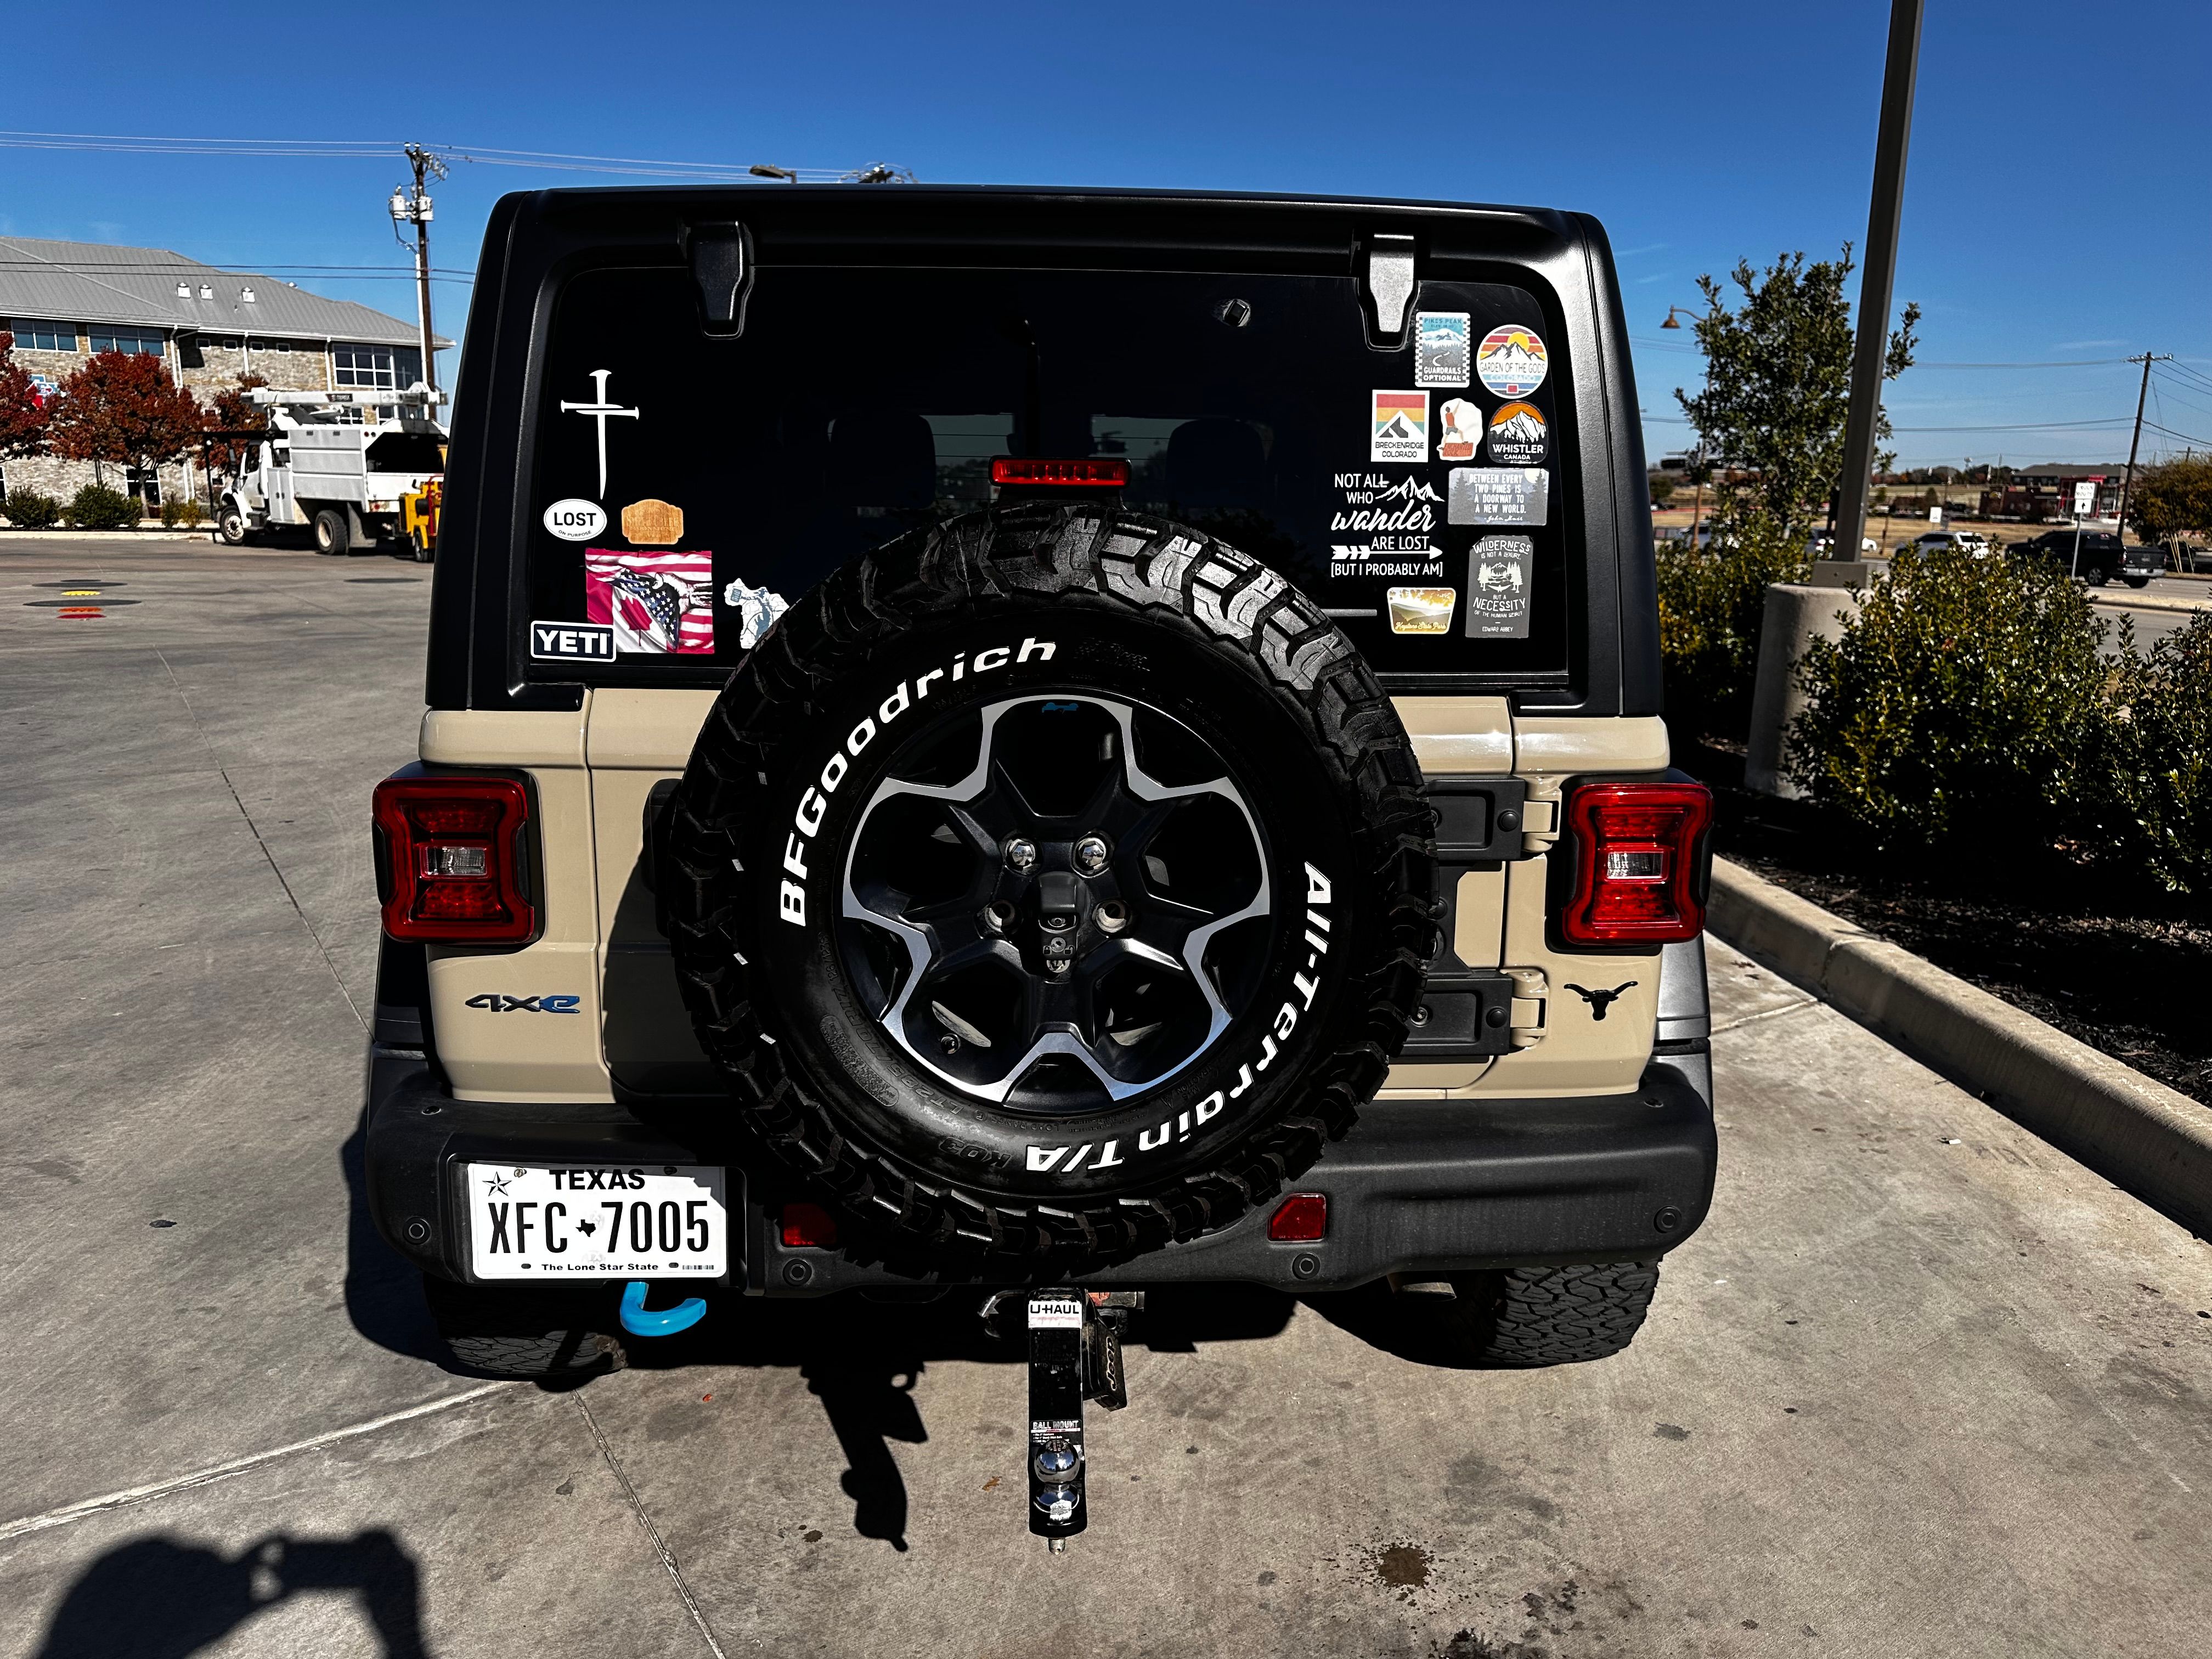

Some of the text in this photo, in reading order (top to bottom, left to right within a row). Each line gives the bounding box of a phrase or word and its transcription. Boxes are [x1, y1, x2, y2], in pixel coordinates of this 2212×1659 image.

[1480, 362, 1545, 374] GARDEN OF THE GODS
[1492, 444, 1544, 454] WHISTLER
[1334, 473, 1387, 488] NOT ALL
[1469, 473, 1523, 484] BETWEEN EVERY
[1474, 484, 1521, 494] TWO PINES IS
[1346, 492, 1373, 504] WHO
[1474, 494, 1524, 504] A DOORWAY TO
[1330, 499, 1436, 532] wander
[1475, 504, 1527, 514] A NEW WORLD.
[554, 512, 596, 526] LOST
[1372, 535, 1430, 550] ARE LOST
[1473, 540, 1531, 555] WILDERNESS
[1331, 562, 1443, 578] [BUT I PROBABLY AM]
[1473, 597, 1526, 612] NECESSITY
[1395, 621, 1447, 631] Keystone State Park
[537, 629, 607, 654] YETI
[780, 636, 1058, 926] BFGoodrich
[1138, 861, 1332, 1154] All-Terrain
[991, 1115, 1027, 1131] RANGE
[1030, 1122, 1060, 1133] LOAD
[1025, 1138, 1124, 1173] T/A
[549, 1169, 645, 1190] TEXAS
[488, 1200, 709, 1254] XFC 7005
[600, 1263, 624, 1271] Star
[627, 1262, 659, 1271] State
[1030, 1304, 1079, 1314] U-HAUL
[1106, 1336, 1118, 1391] Jeep
[1032, 1420, 1079, 1430] BALL MOUNT
